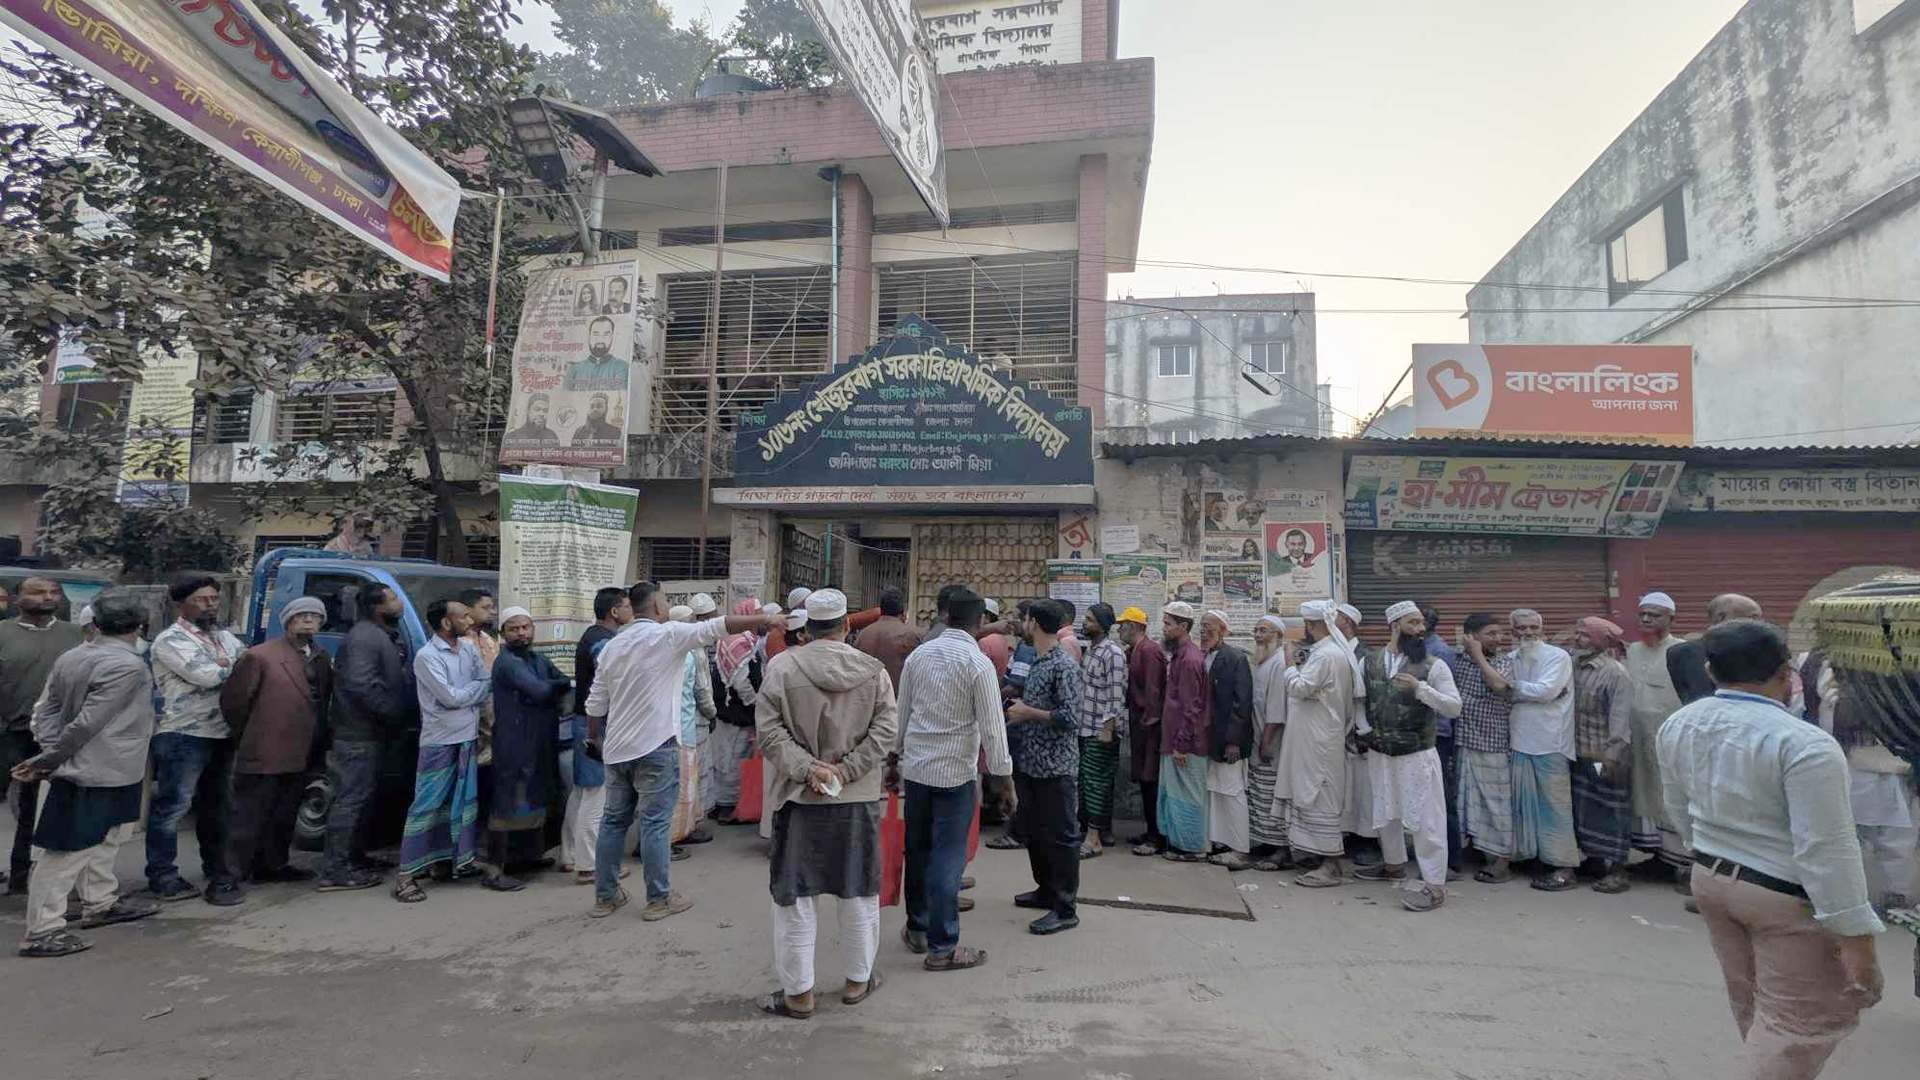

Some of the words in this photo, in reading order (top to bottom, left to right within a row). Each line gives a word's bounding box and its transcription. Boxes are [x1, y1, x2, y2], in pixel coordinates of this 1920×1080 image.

[982, 23, 1054, 45] বিদ্যালয়
[174, 76, 241, 129] দক্ষিণ
[1505, 364, 1679, 396] বাংলালিংক
[806, 357, 885, 423] খেজুরবাগ
[882, 346, 945, 380] সরকারি
[998, 385, 1070, 460] বিদ্যালয়
[1592, 399, 1646, 412] আপনার
[1648, 399, 1679, 412] জন্য
[1719, 477, 1770, 492] মায়ের
[1417, 539, 1511, 556] KANSAI
